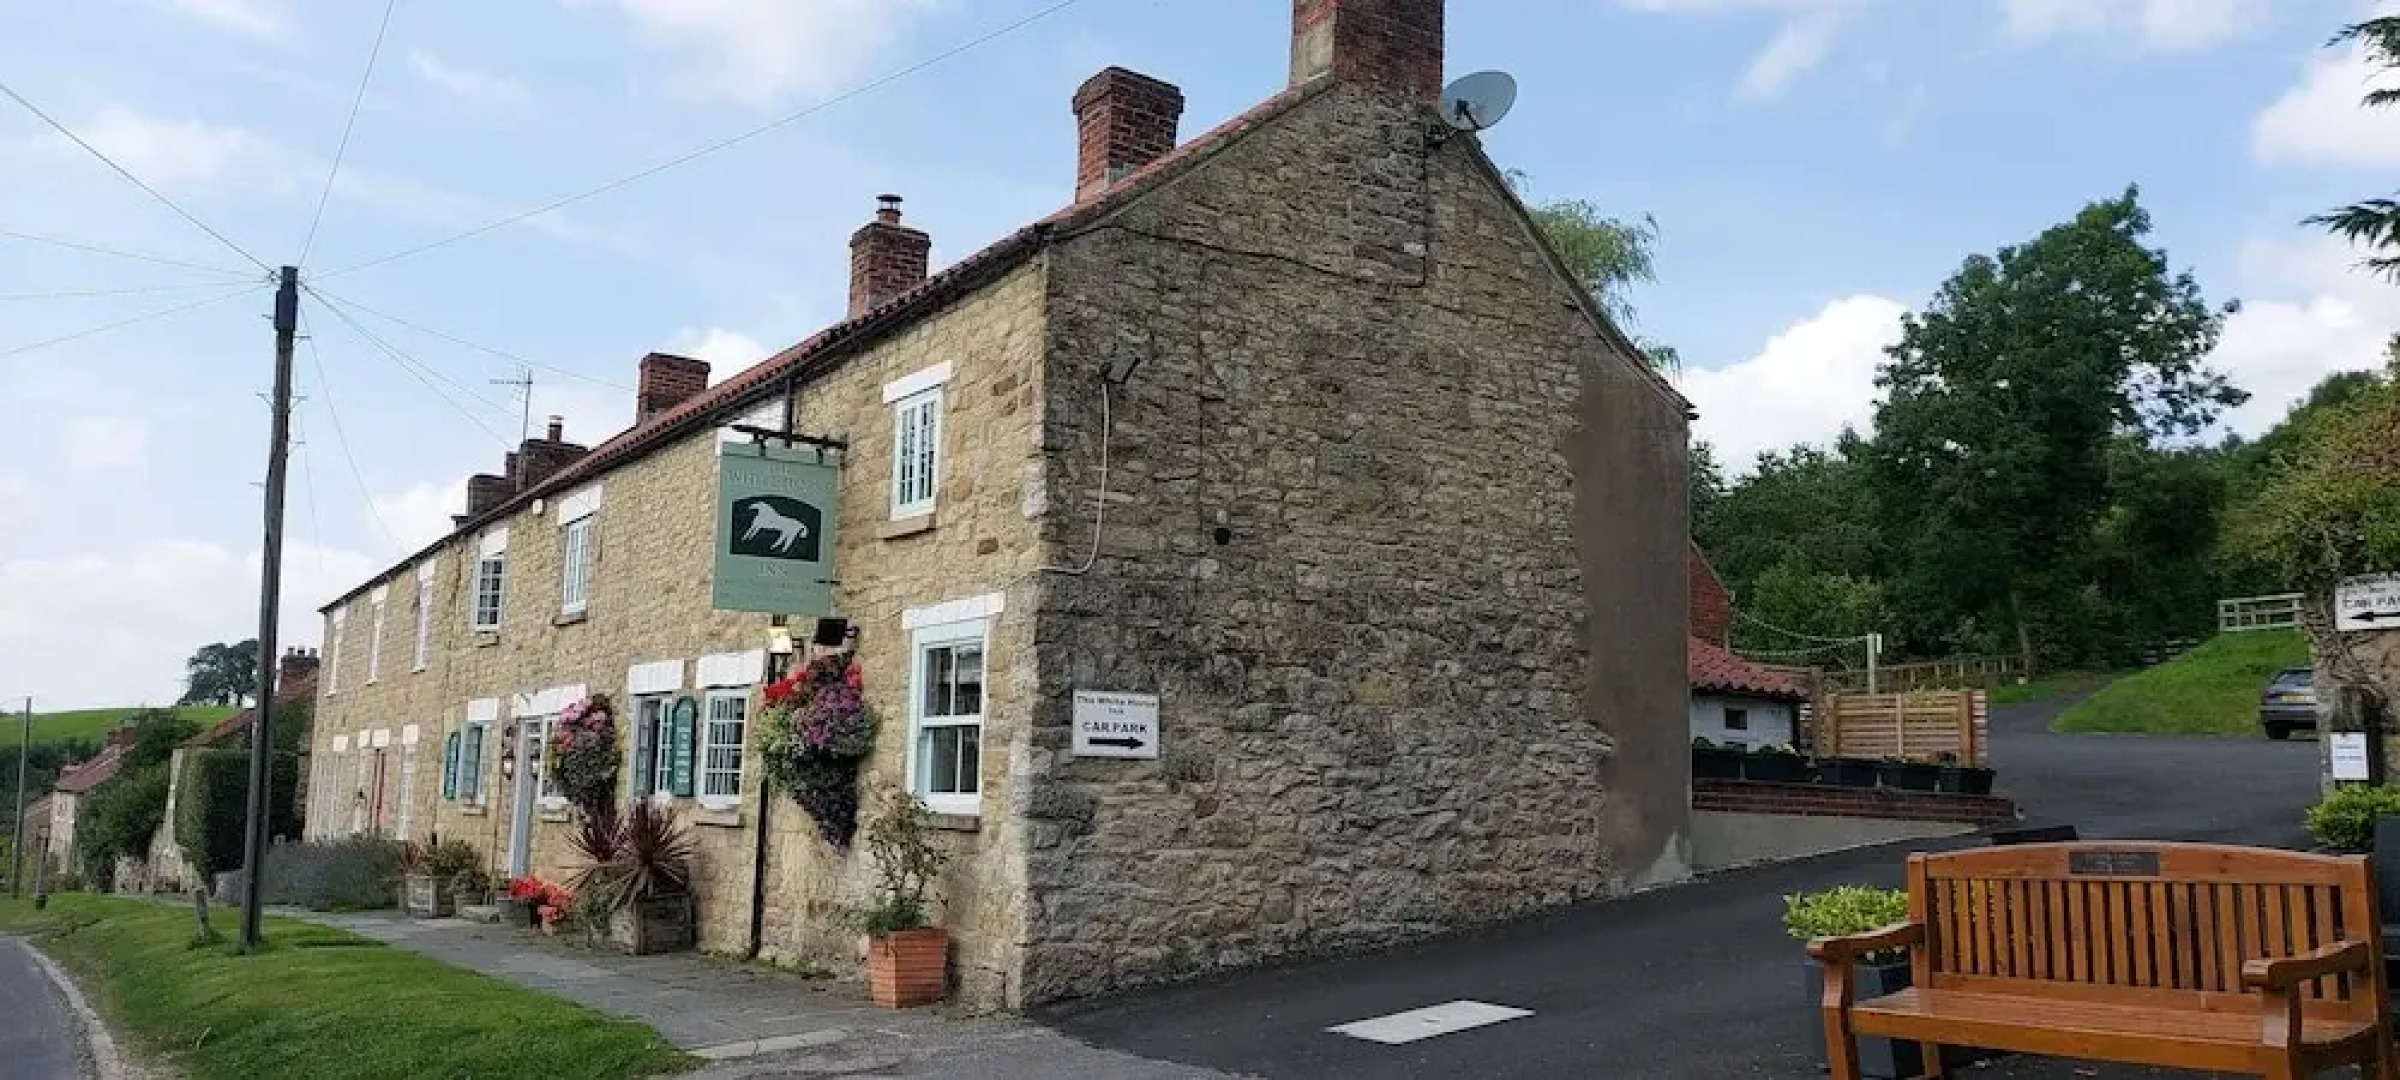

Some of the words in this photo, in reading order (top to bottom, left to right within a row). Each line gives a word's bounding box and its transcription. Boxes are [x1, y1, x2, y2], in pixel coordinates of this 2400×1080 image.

[1098, 697, 1126, 706] White
[1082, 721, 1111, 733] CAR
[1113, 722, 1148, 734] PARK
